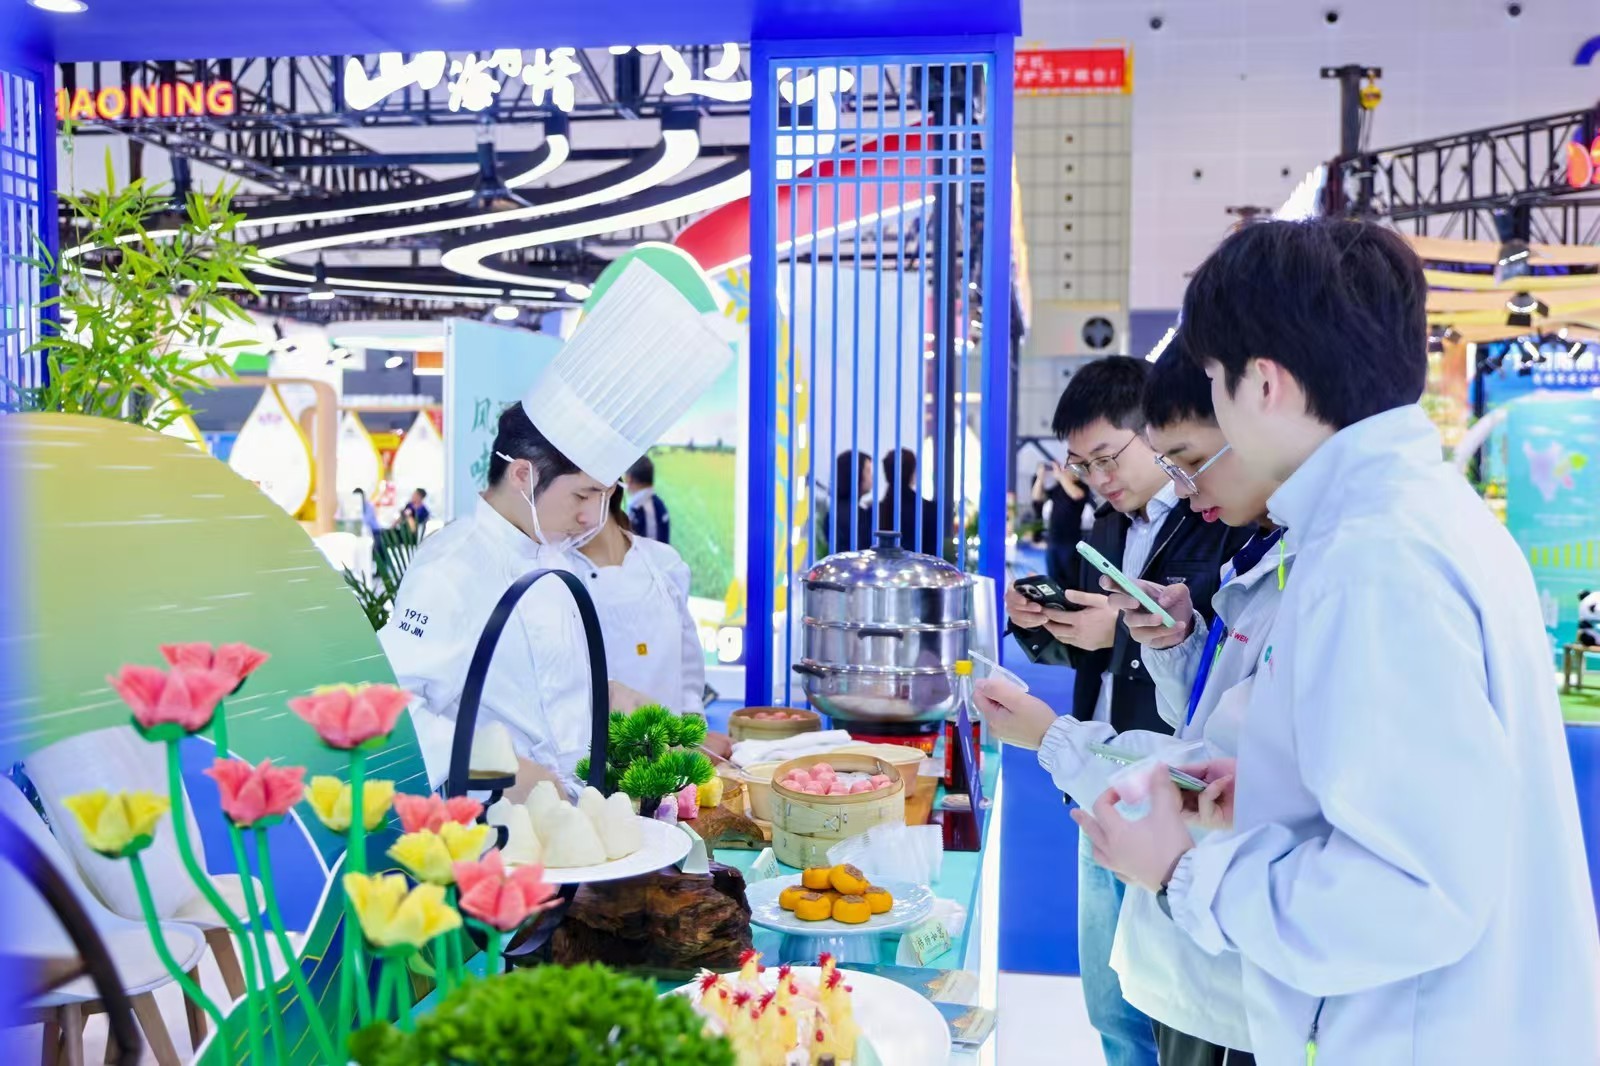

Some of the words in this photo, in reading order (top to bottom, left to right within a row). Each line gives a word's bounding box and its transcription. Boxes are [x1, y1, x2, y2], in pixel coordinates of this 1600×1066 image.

[56, 80, 236, 120] IAONING
[404, 608, 429, 625] 1913
[398, 620, 411, 632] XU
[410, 626, 424, 638] JIN
